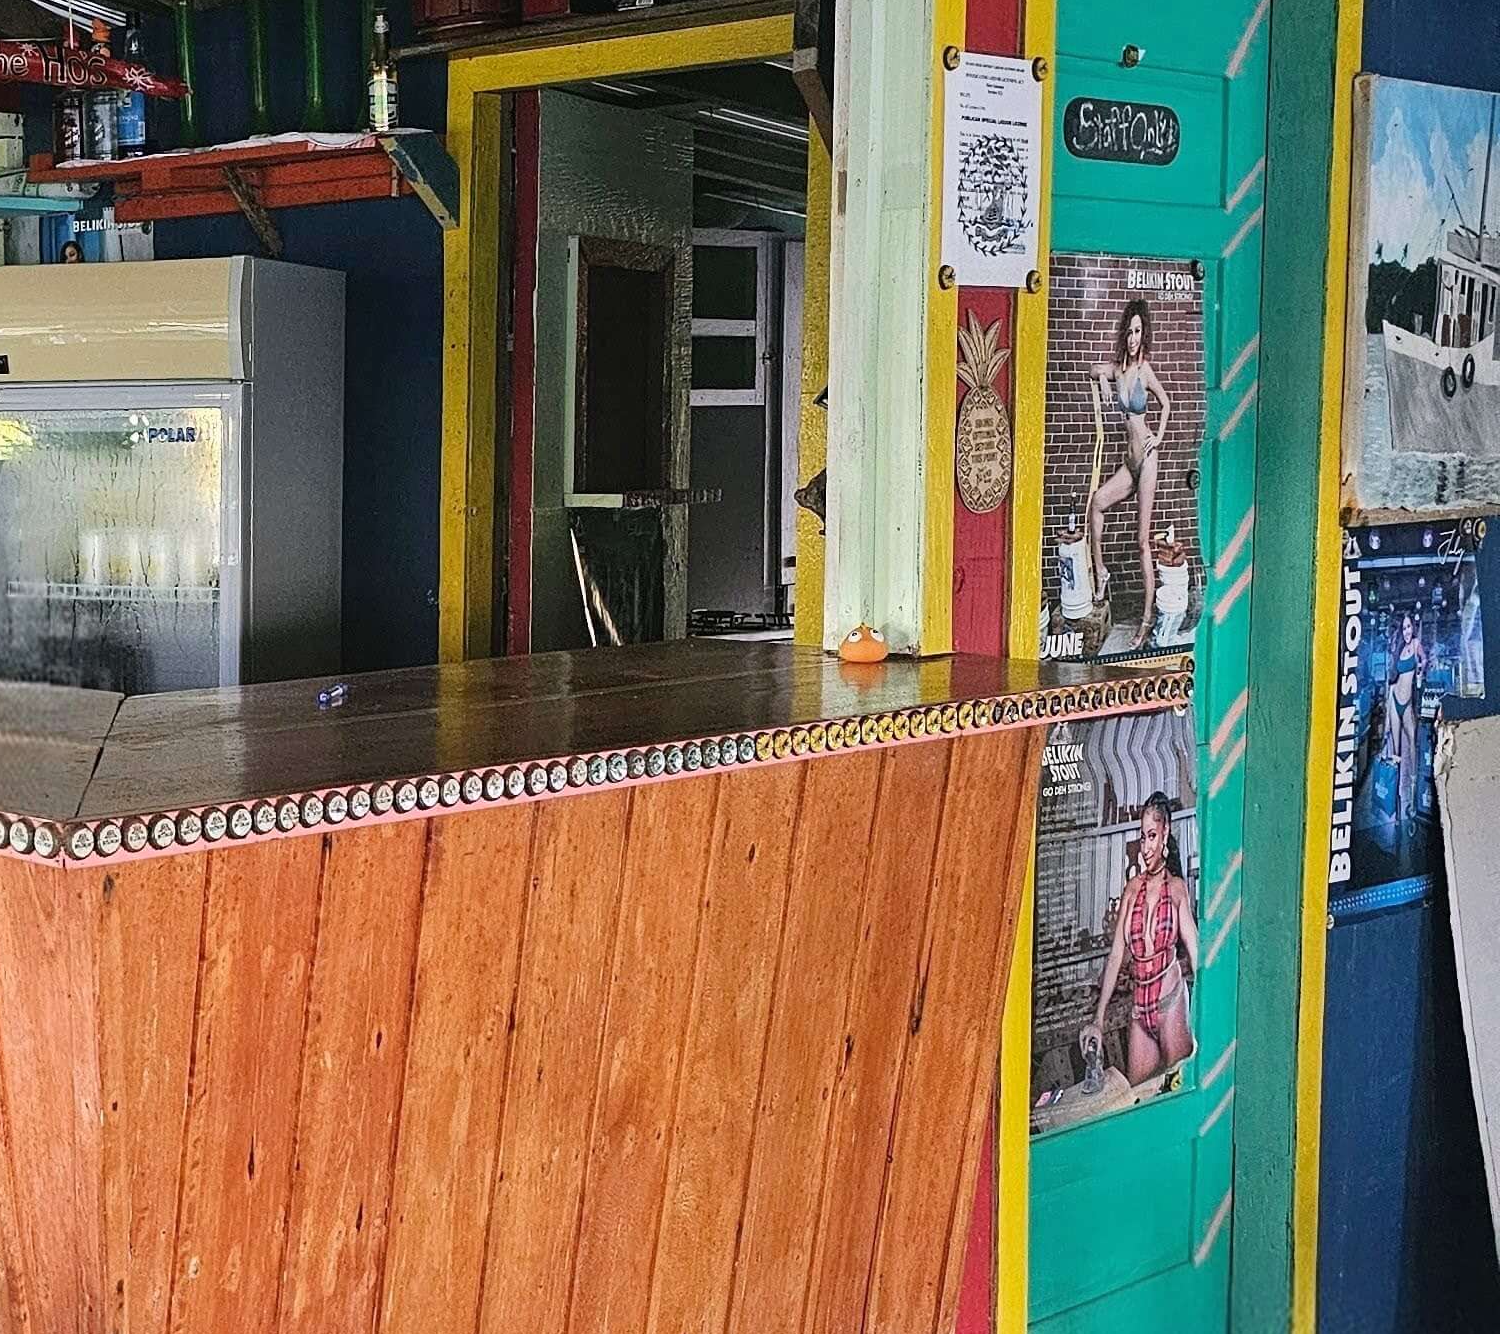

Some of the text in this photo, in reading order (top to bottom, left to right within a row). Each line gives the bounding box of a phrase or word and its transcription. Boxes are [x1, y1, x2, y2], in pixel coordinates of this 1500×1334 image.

[1072, 101, 1133, 151] Staff
[1127, 269, 1195, 291] BELIKIN STOUT
[148, 427, 197, 444] POLAR
[1438, 528, 1467, 575] July
[1040, 632, 1085, 659] JUNE
[1328, 567, 1363, 885] BELIKIN STOUT
[1041, 743, 1085, 767] BELIKIN
[1050, 763, 1082, 783] STOUT
[1042, 784, 1054, 797] GO
